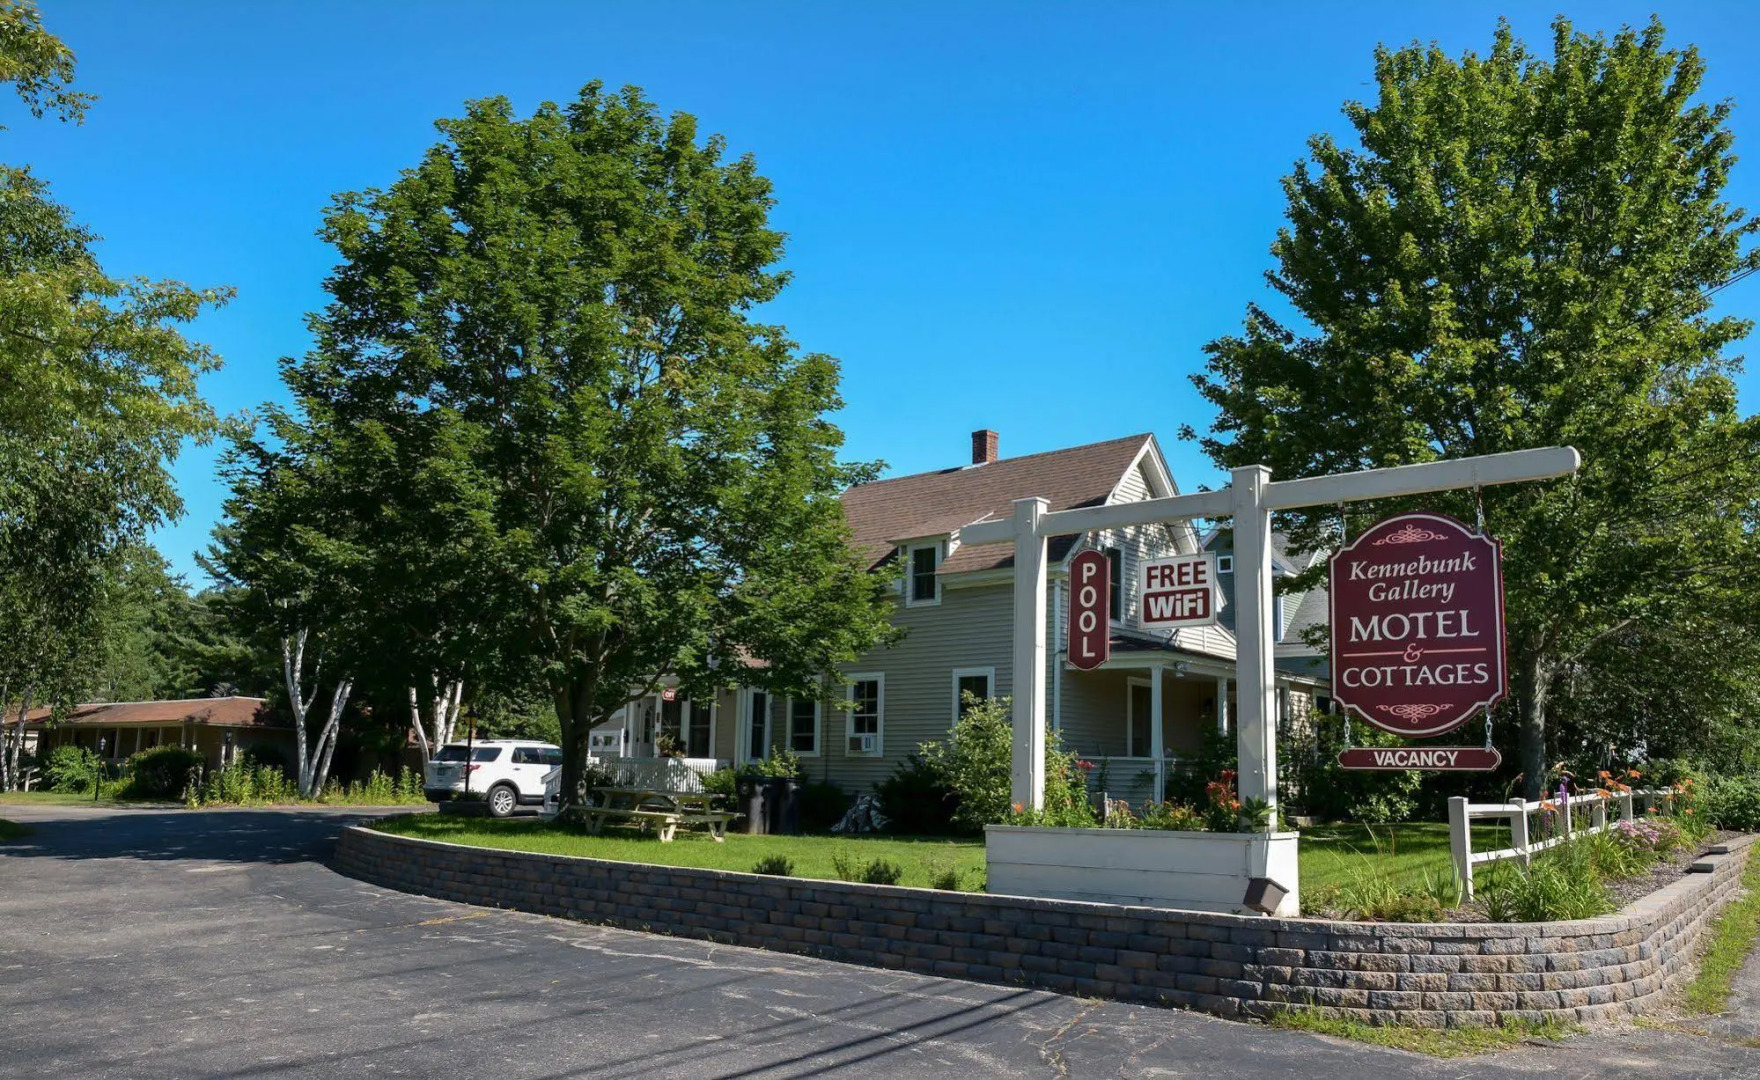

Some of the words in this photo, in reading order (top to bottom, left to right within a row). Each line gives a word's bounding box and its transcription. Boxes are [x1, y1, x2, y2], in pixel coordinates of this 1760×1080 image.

[1146, 561, 1207, 589] FREE
[1349, 551, 1476, 581] Kennebunk
[1368, 579, 1455, 604] Gallery
[1079, 562, 1097, 658] POOL
[1148, 592, 1204, 619] WiFi
[1349, 610, 1480, 642] MOTEL
[1403, 643, 1423, 663] &
[1342, 663, 1489, 687] COTTAGES
[1374, 751, 1458, 766] VACANCY
